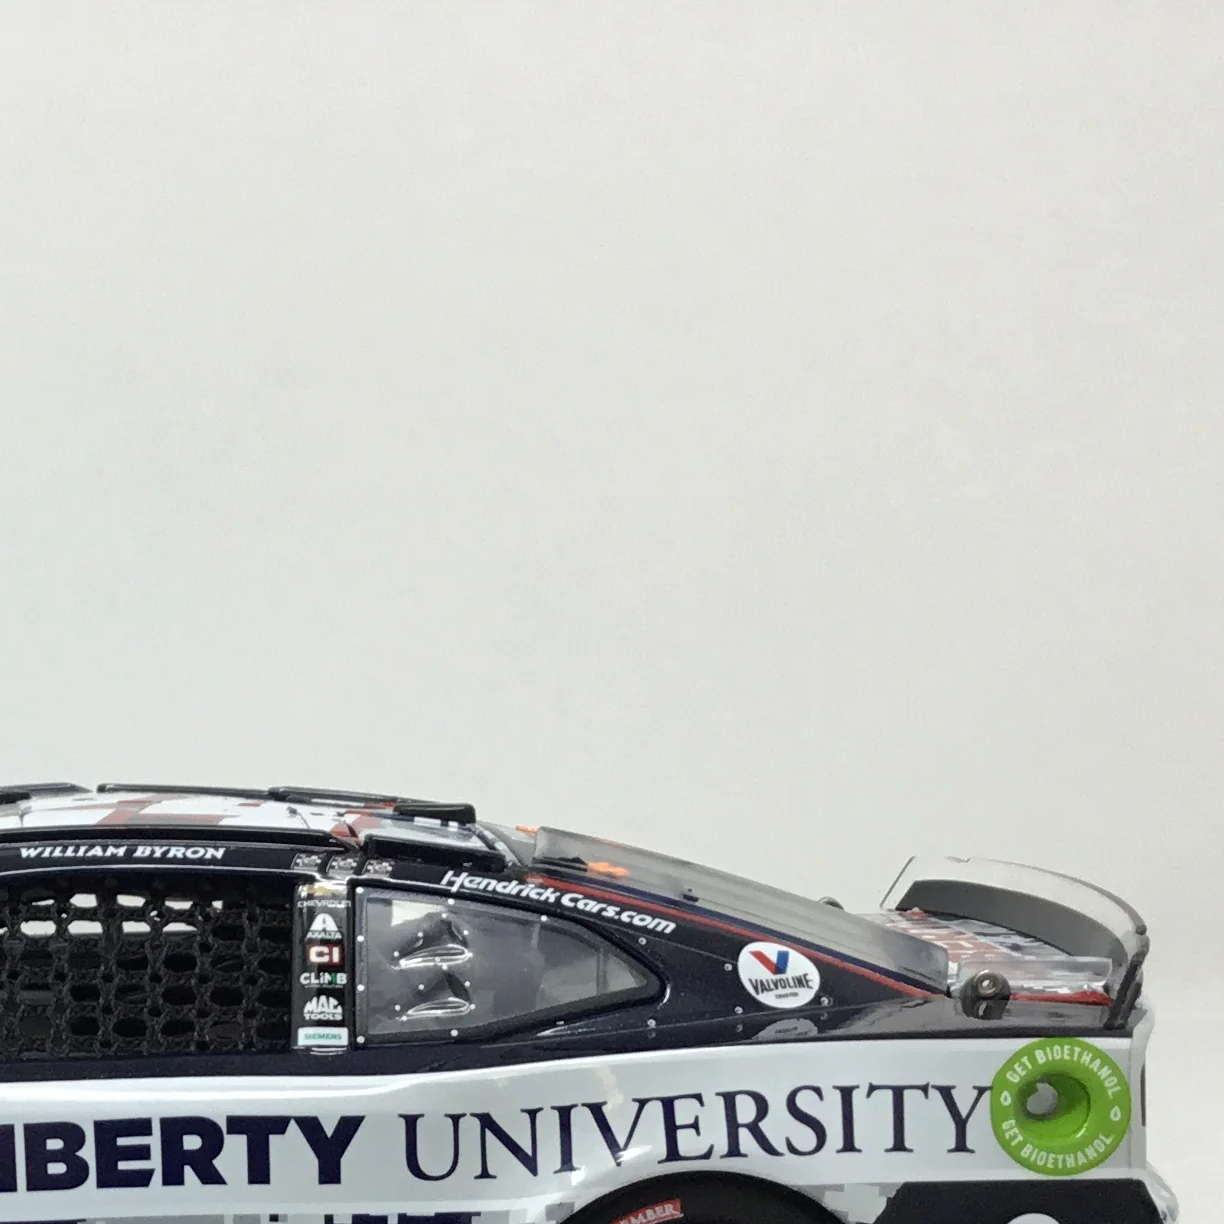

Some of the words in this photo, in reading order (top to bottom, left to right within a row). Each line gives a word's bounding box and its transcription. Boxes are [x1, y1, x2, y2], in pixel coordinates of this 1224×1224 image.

[20, 845, 127, 859] WILLIAM
[132, 845, 226, 860] BYRON
[306, 931, 343, 940] AXALTA
[309, 944, 340, 963] CI
[748, 972, 814, 997] VALVOLINE
[303, 994, 343, 1013] MAC
[303, 1012, 343, 1021] TOOLS
[303, 1032, 343, 1041] SIEMENS
[1006, 1056, 1033, 1084] GET
[1034, 1044, 1122, 1100] BIOETHANOL
[398, 1082, 993, 1181] UNIVERSITY
[1001, 1118, 1024, 1147] GET
[1020, 1133, 1117, 1170] BIOETHANOL
